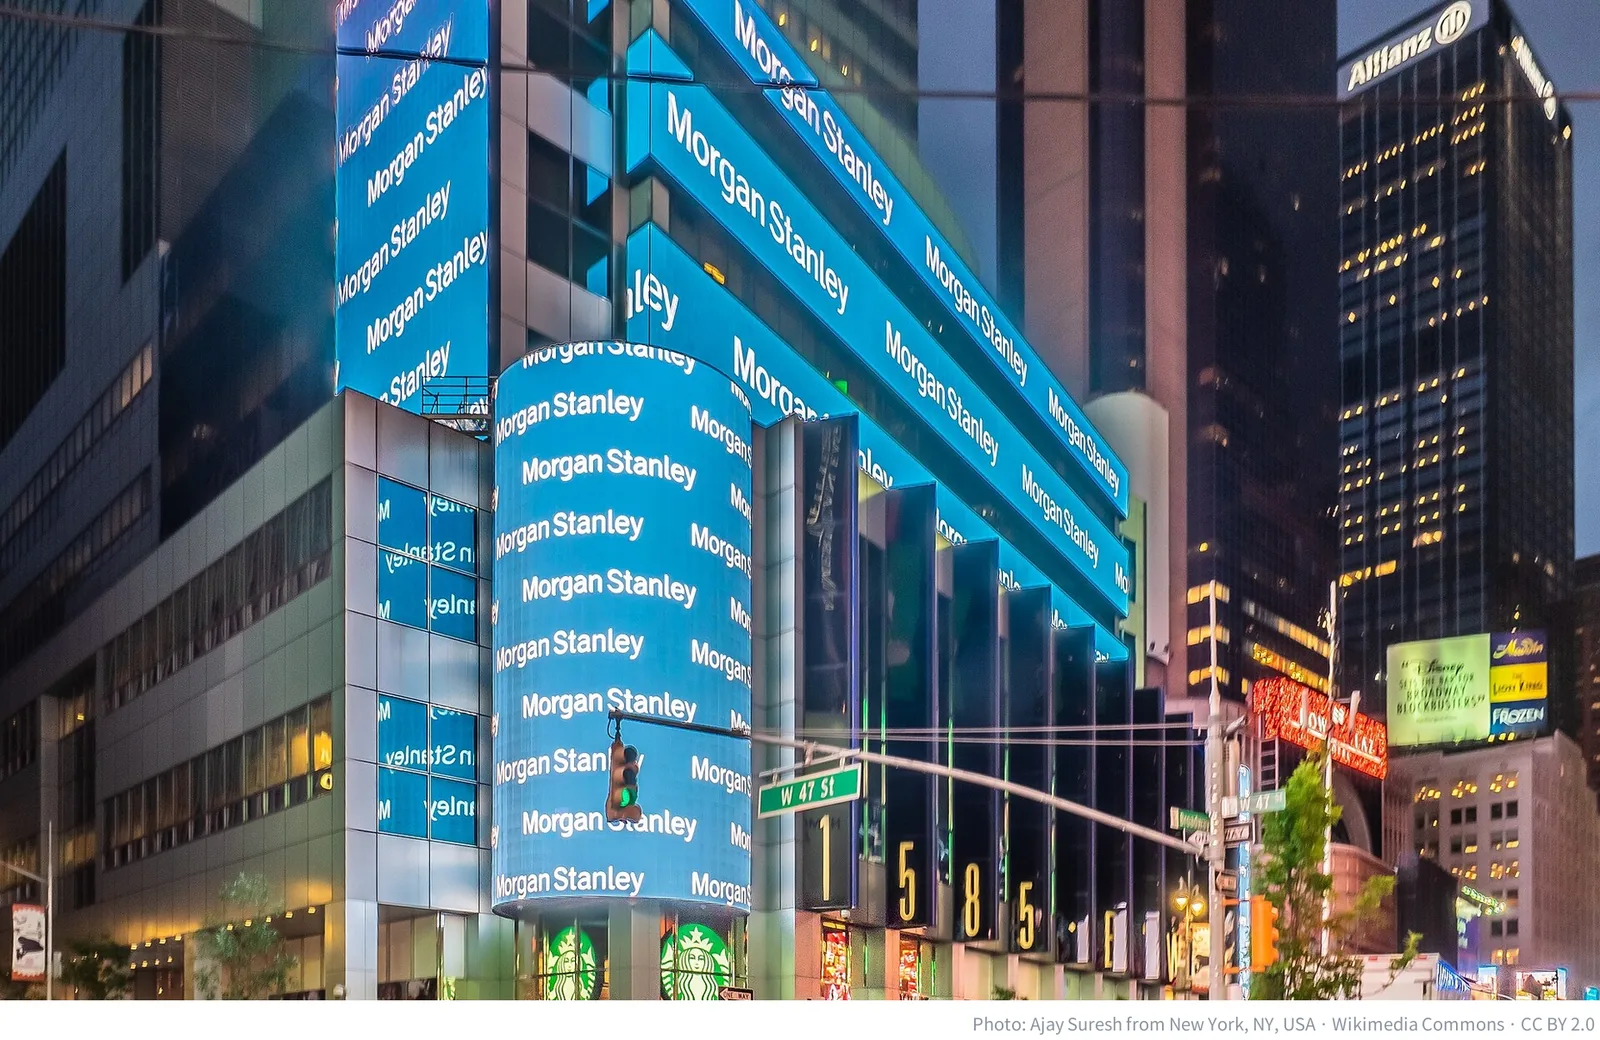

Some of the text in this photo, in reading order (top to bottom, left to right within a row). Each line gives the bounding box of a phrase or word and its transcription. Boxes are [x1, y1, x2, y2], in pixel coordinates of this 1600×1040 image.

[1348, 27, 1432, 91] Allianz
[338, 92, 390, 167] Morgan
[367, 66, 487, 208] Morgan Stanley
[823, 110, 893, 226] Stanley
[667, 91, 848, 315] Morgan Stanley
[337, 181, 450, 306] Morgan Stanley
[367, 230, 488, 354] Morgan Stanley
[926, 235, 1027, 387] Morgan Stanley
[496, 400, 550, 447] Morgan
[553, 389, 644, 422] Stanley
[886, 320, 945, 410] Morgan
[947, 386, 999, 467] Stanley
[522, 447, 697, 492] Morgan Stanley
[1049, 387, 1120, 498] Morgan Stanley
[496, 509, 644, 561] Morgan Stanley
[1022, 464, 1099, 569] Morgan Stanley
[522, 568, 697, 610] Morgan Stanley
[496, 628, 644, 673] Morgan Stanley
[522, 687, 697, 724] Morgan Stanley
[1492, 706, 1545, 726] FROZEN
[496, 755, 550, 786] Morgan
[781, 775, 835, 807] W 47 St
[522, 810, 603, 838] Morgan
[496, 866, 644, 899] Morgan Stanley
[819, 814, 830, 901] 1
[899, 841, 916, 921] 5
[965, 862, 980, 937] 8
[1018, 881, 1035, 949] 5
